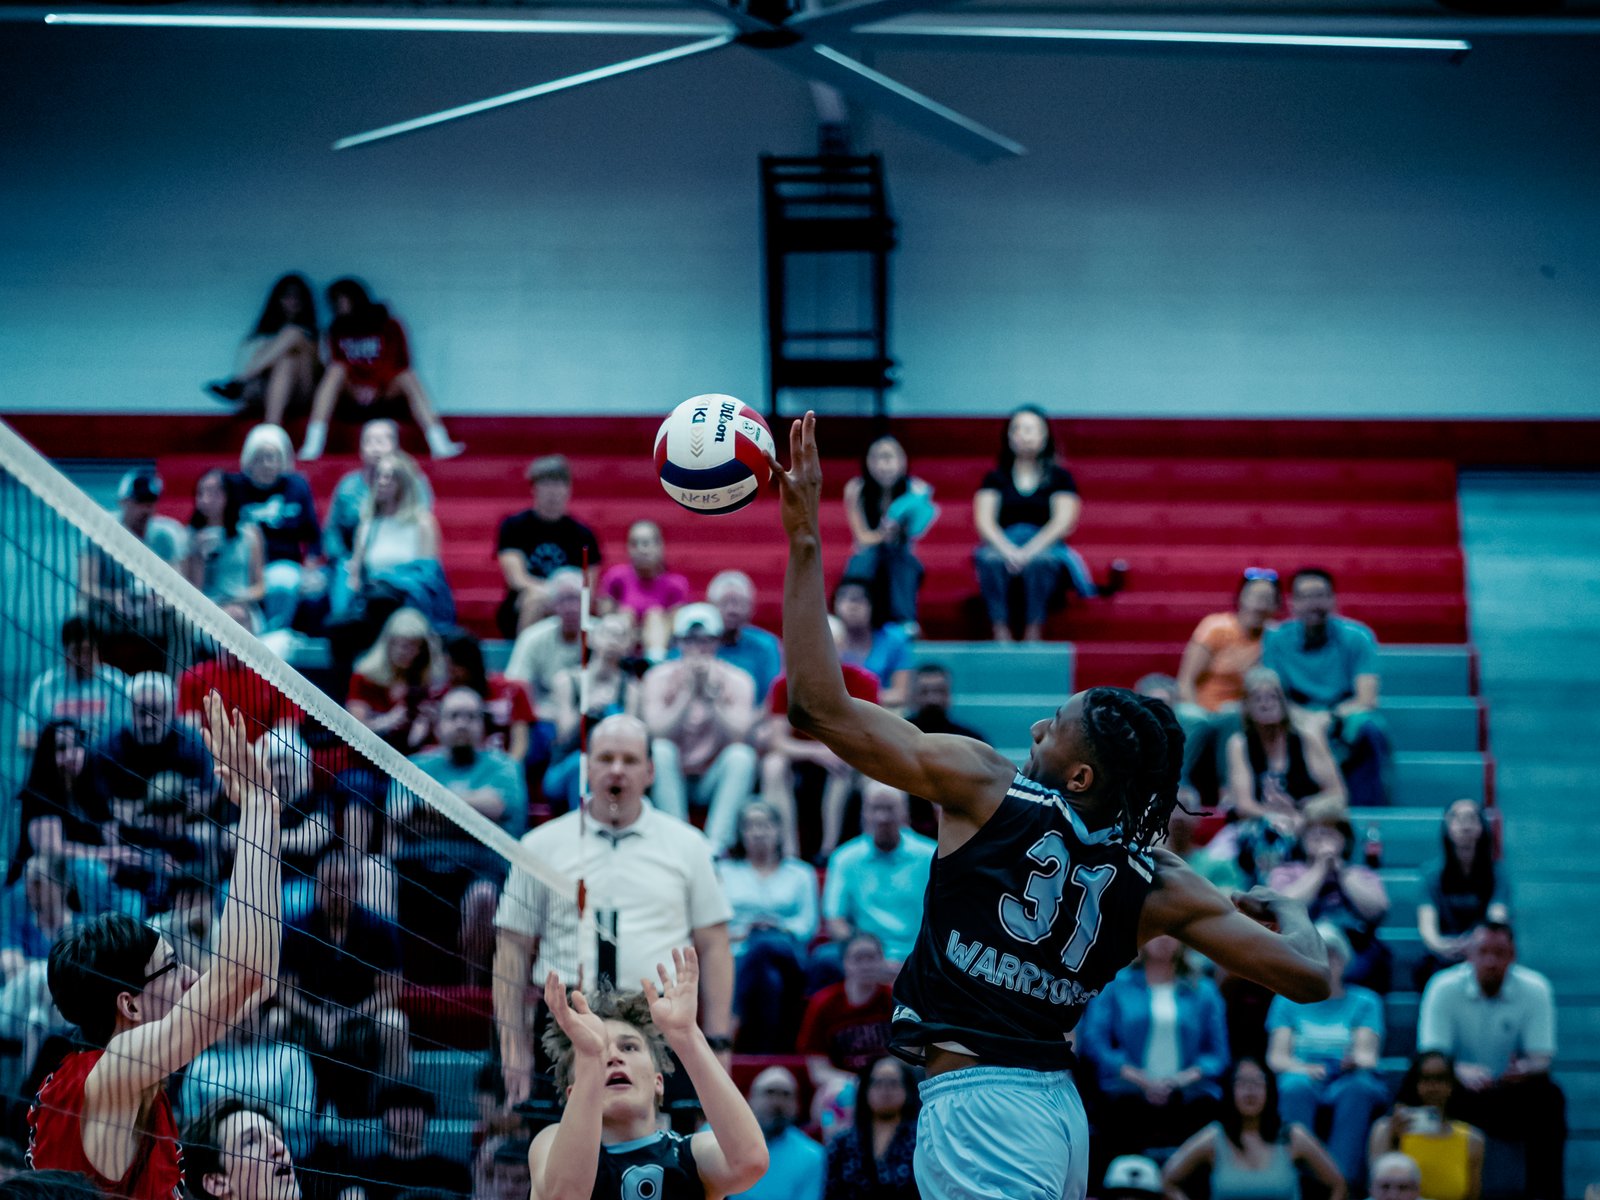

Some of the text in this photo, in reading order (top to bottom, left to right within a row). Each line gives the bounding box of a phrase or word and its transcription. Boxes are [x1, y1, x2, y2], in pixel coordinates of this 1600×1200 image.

[714, 402, 736, 442] Wilson
[681, 492, 720, 504] NCHS
[998, 830, 1117, 973] 31
